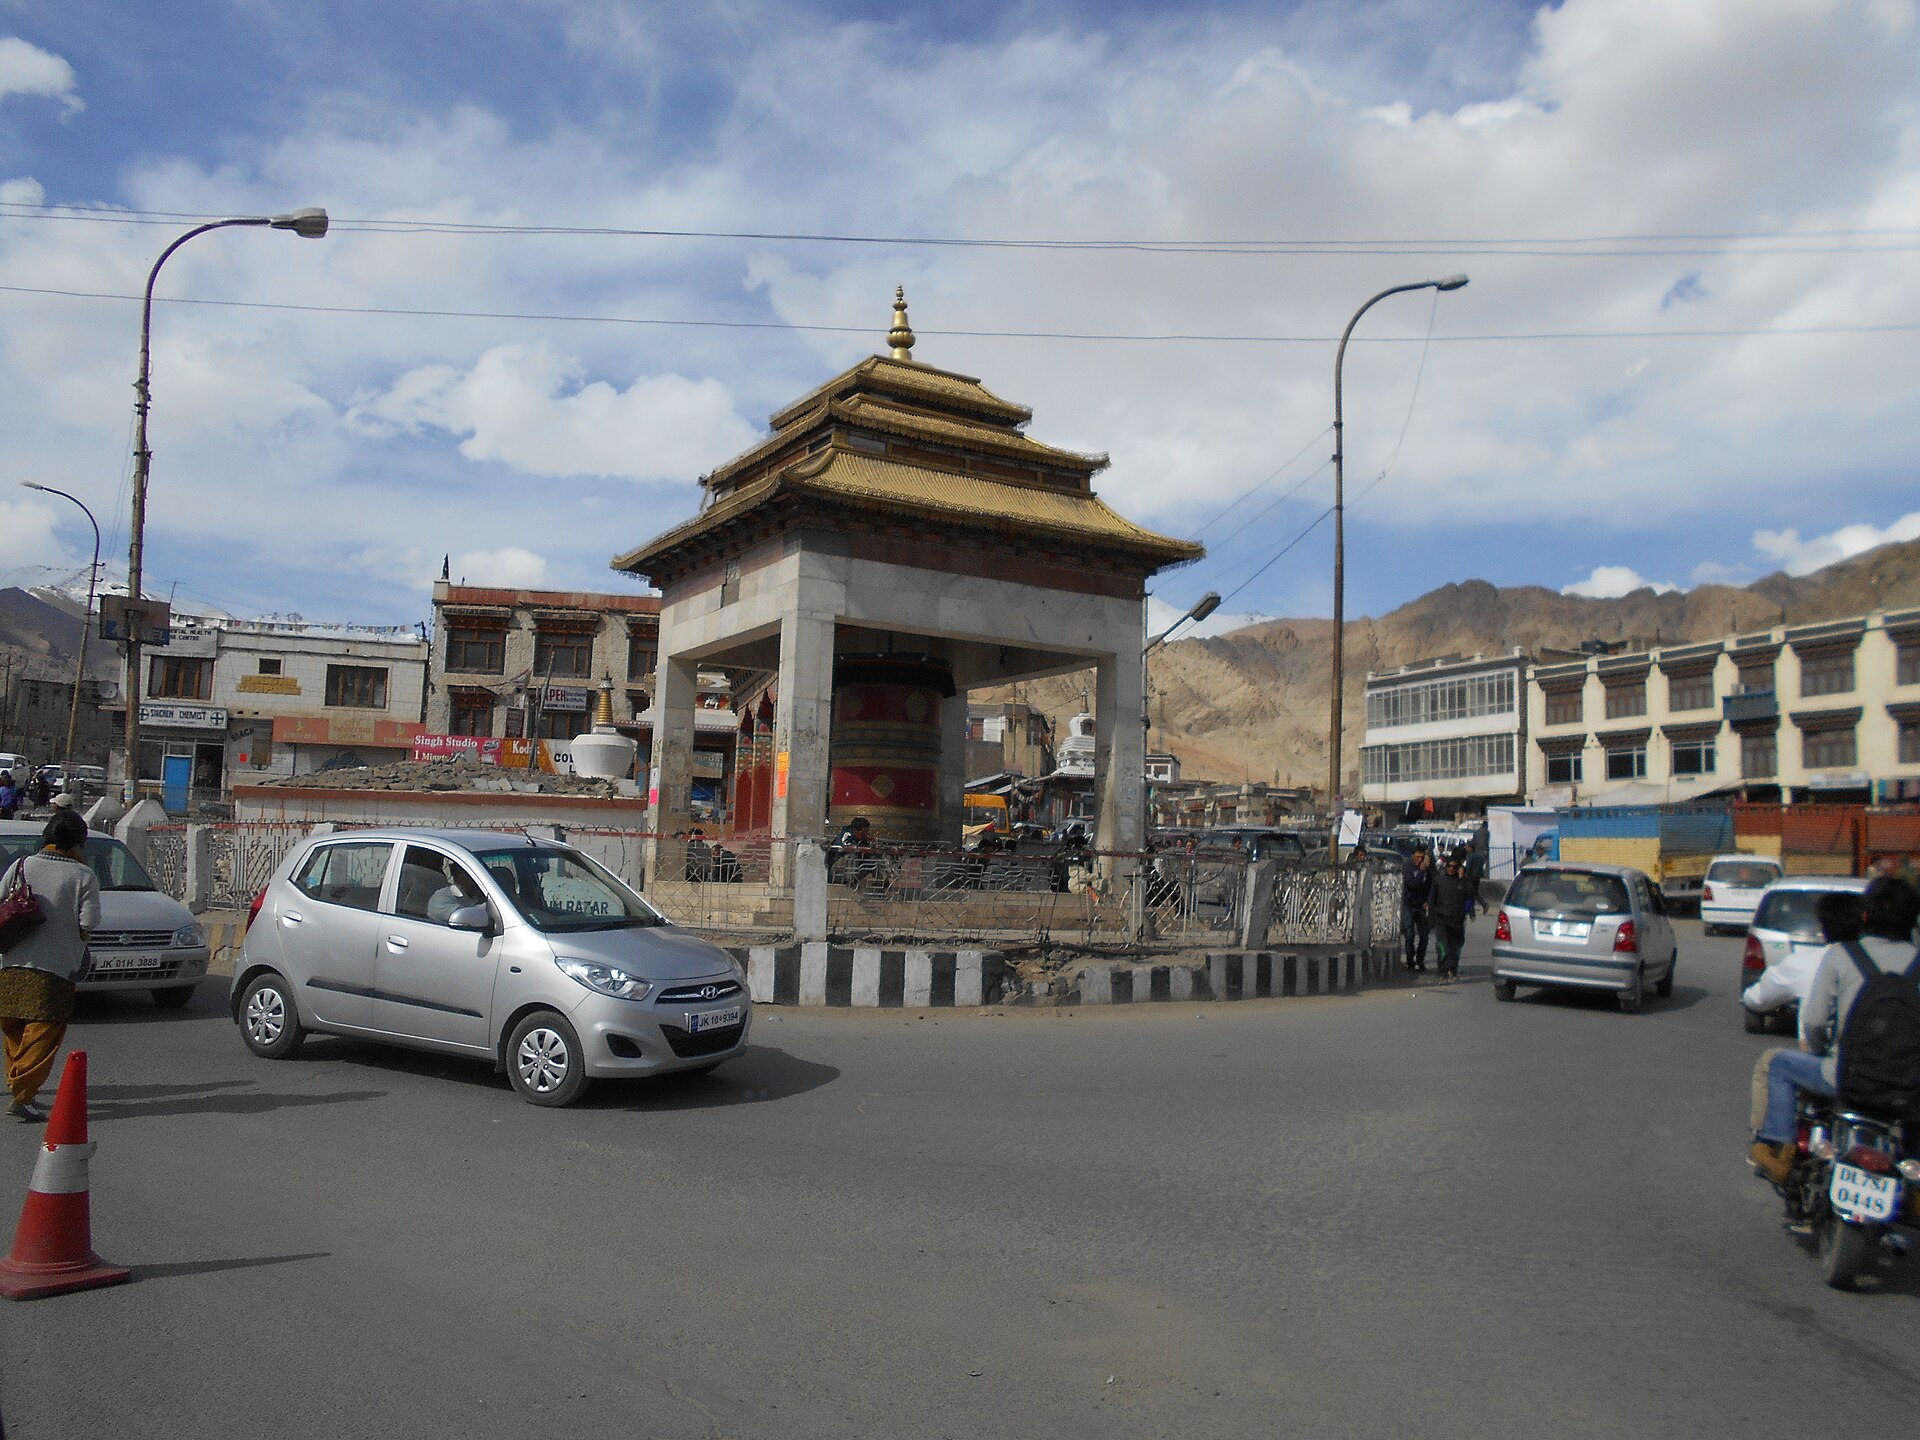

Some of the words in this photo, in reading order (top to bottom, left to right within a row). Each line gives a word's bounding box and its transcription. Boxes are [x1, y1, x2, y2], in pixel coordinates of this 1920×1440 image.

[179, 710, 207, 720] CHEMIST
[415, 735, 443, 748] Singh
[445, 737, 478, 748] Studio
[512, 740, 541, 755] Kod
[415, 750, 420, 760] 1
[101, 960, 113, 969] JK
[699, 1016, 710, 1028] JK
